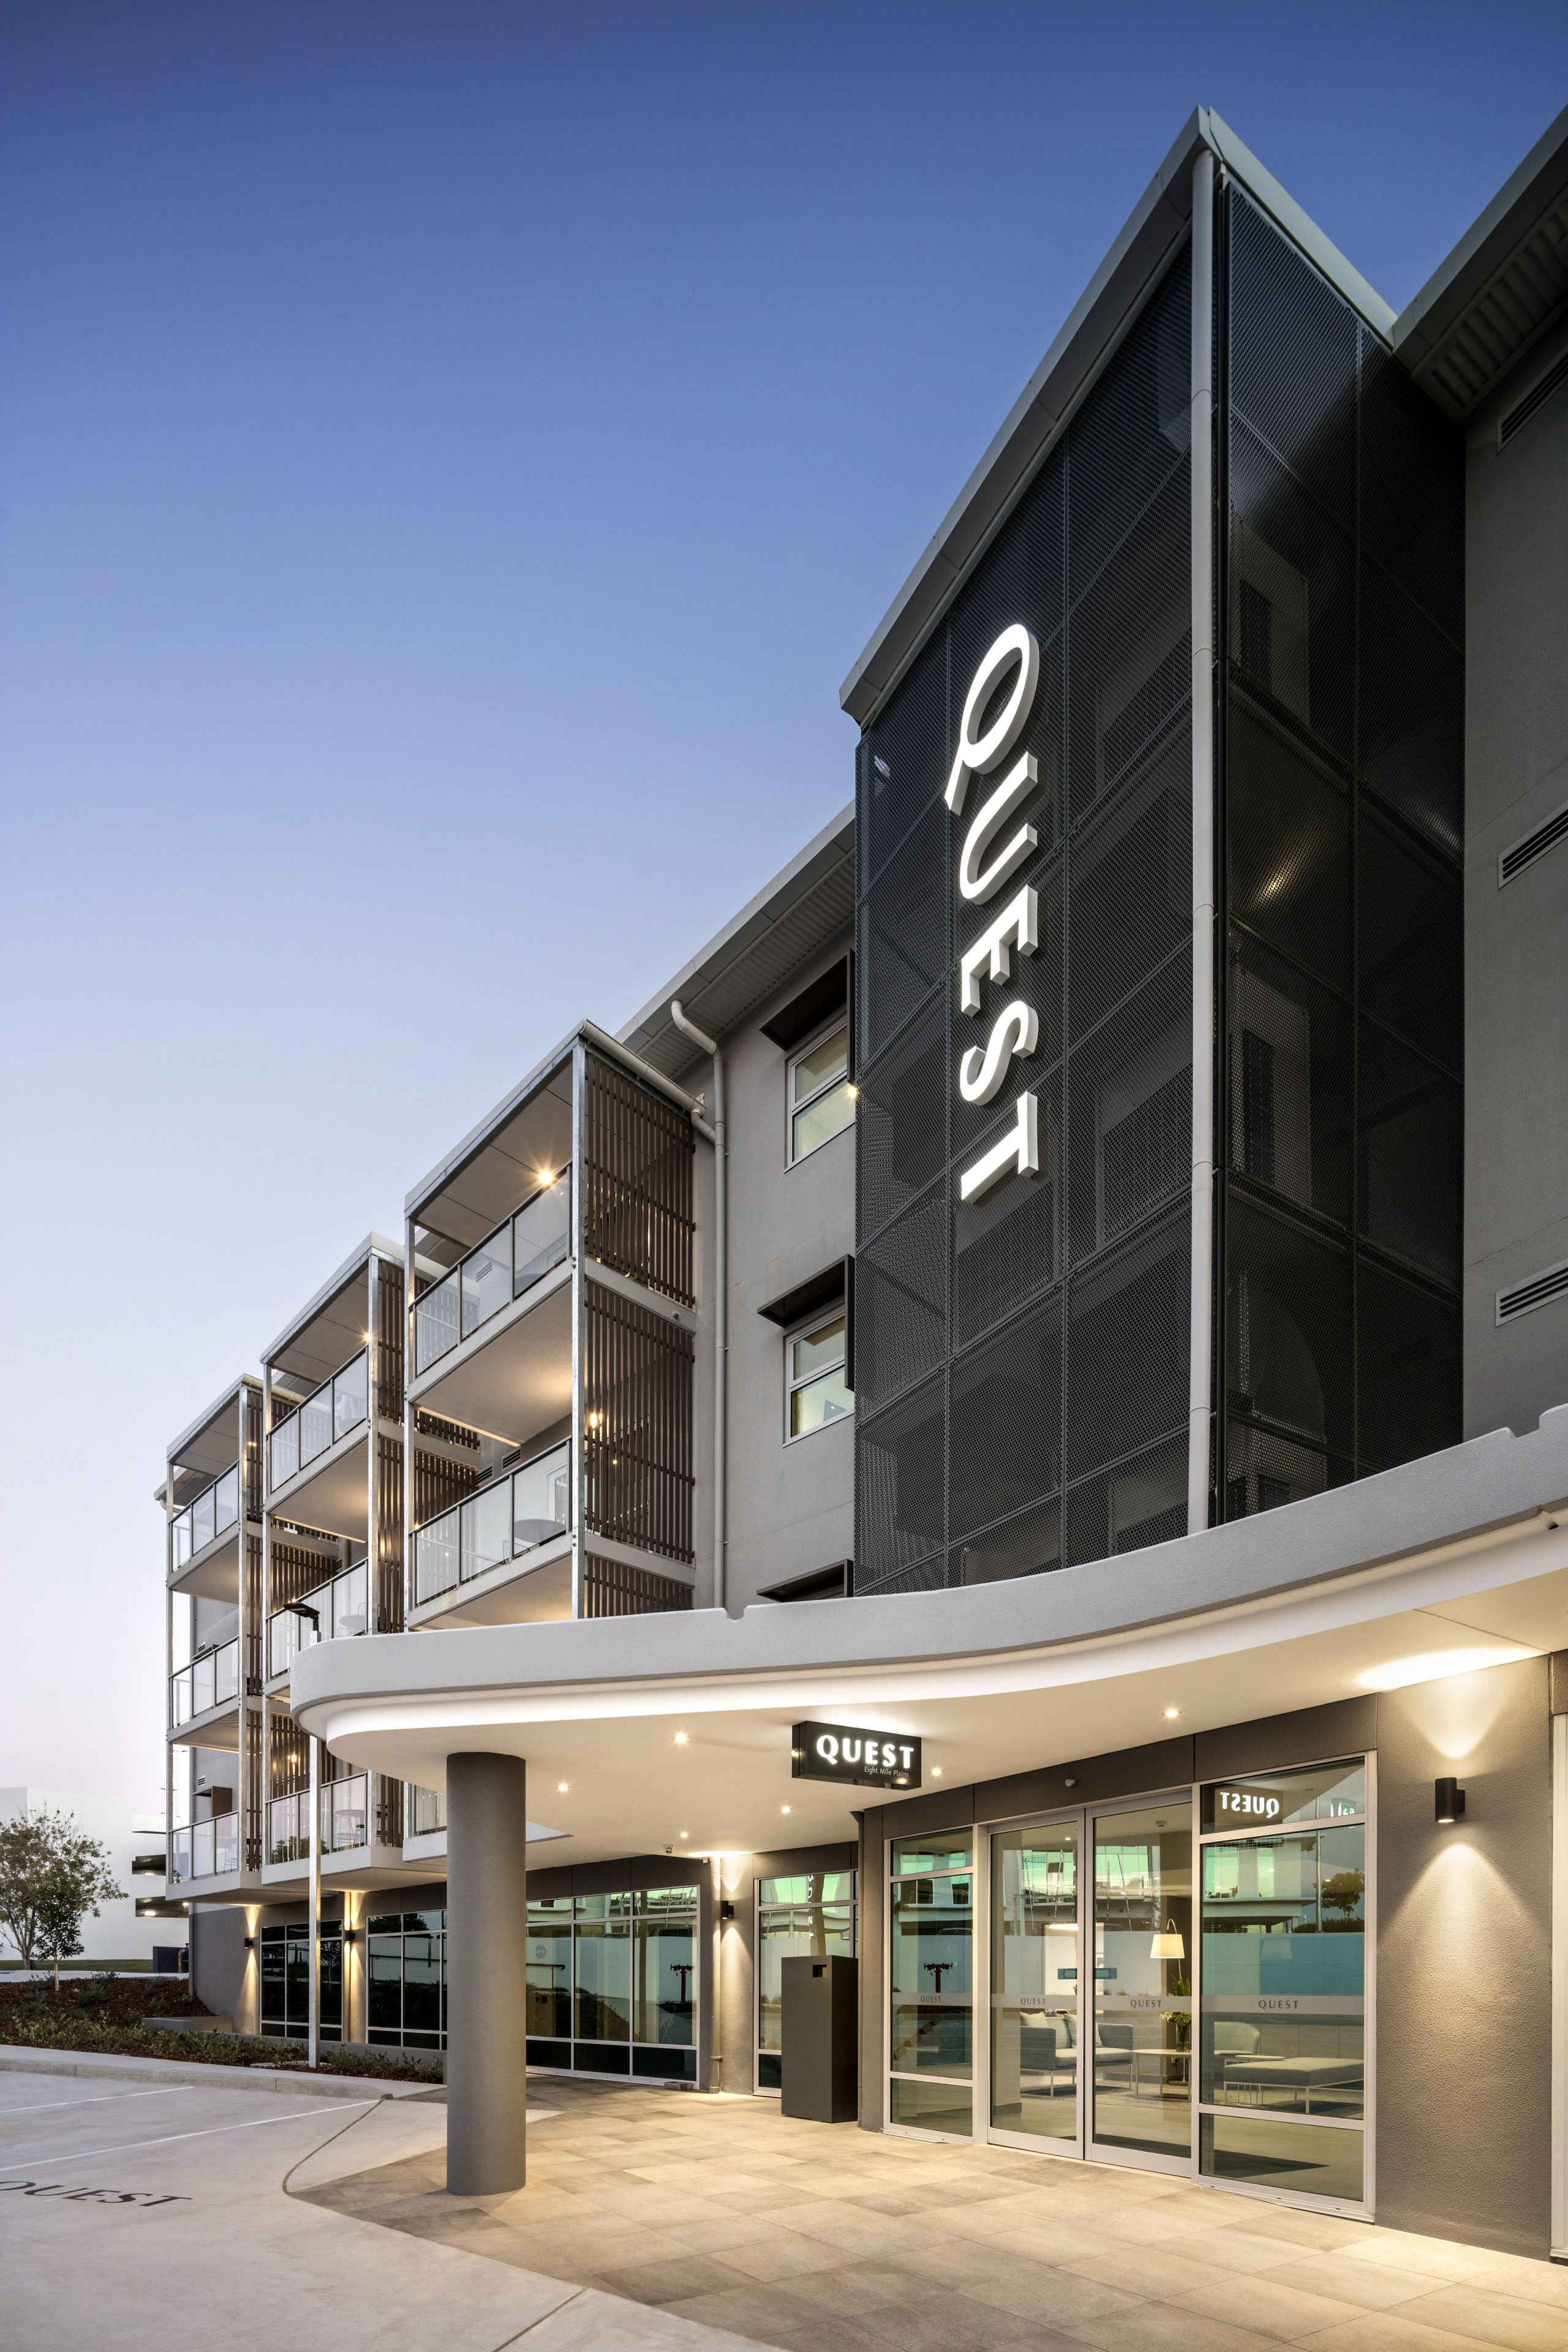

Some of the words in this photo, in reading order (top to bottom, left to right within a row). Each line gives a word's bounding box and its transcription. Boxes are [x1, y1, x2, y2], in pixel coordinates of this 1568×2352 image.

[944, 624, 1039, 1203] QUEST
[816, 1735, 914, 1768] QUEST
[864, 1766, 878, 1774] Eight
[1130, 1999, 1162, 2008] QUEST
[1259, 2000, 1298, 2010] QUEST
